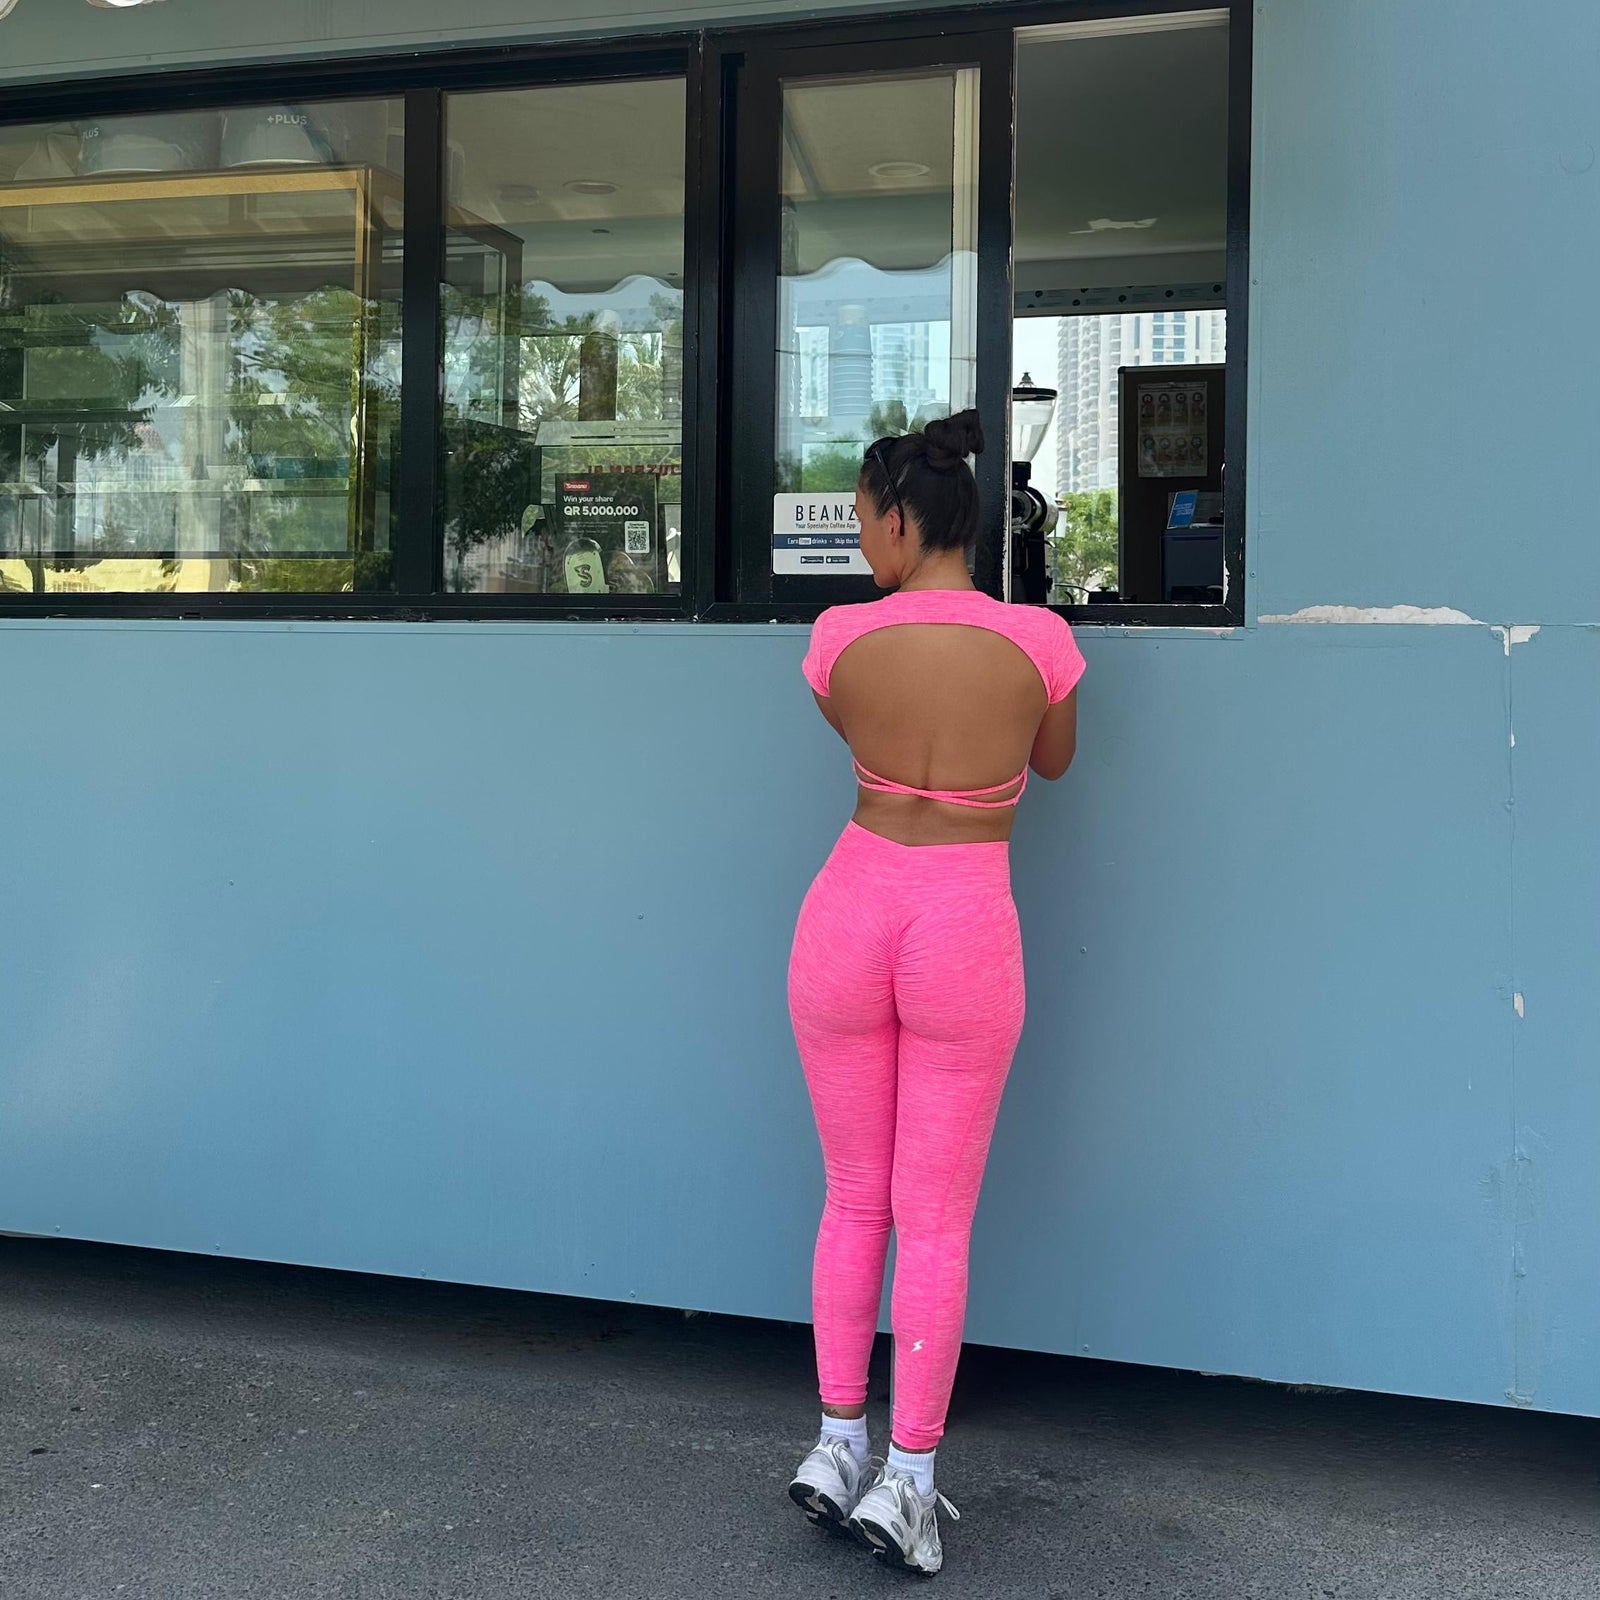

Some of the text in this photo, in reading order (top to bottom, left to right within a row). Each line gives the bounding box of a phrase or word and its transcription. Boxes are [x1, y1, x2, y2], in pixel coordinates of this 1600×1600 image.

[579, 496, 594, 504] your
[595, 495, 614, 503] share
[563, 505, 639, 517] QR 5,000,000
[795, 504, 856, 521] BEANZ
[811, 537, 828, 545] drinks
